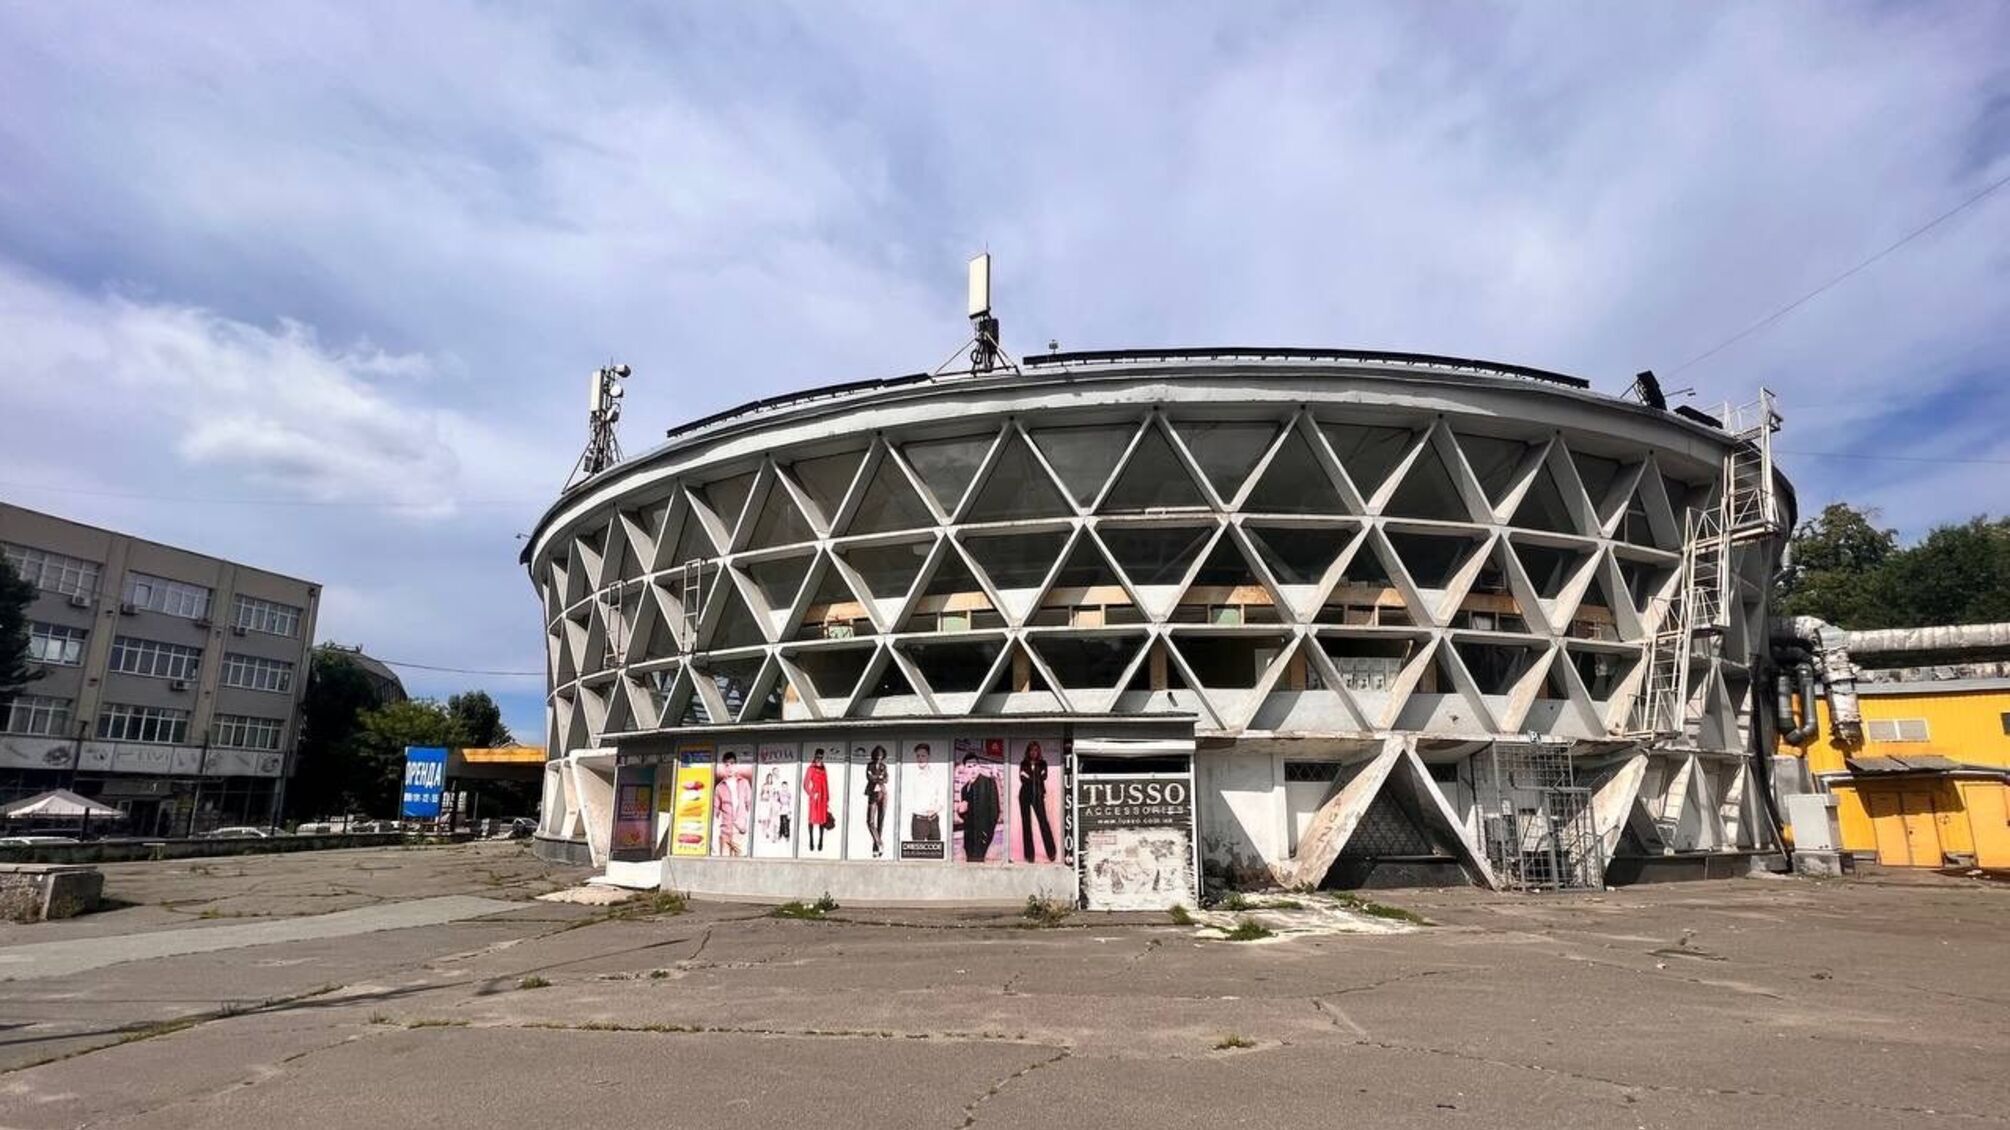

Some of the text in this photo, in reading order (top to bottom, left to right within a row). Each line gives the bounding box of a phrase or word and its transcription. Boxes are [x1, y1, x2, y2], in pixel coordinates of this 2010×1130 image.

[1064, 755, 1074, 850] TUSSO
[1083, 783, 1185, 805] TUSSO
[1085, 806, 1184, 816] ACCESSORIES
